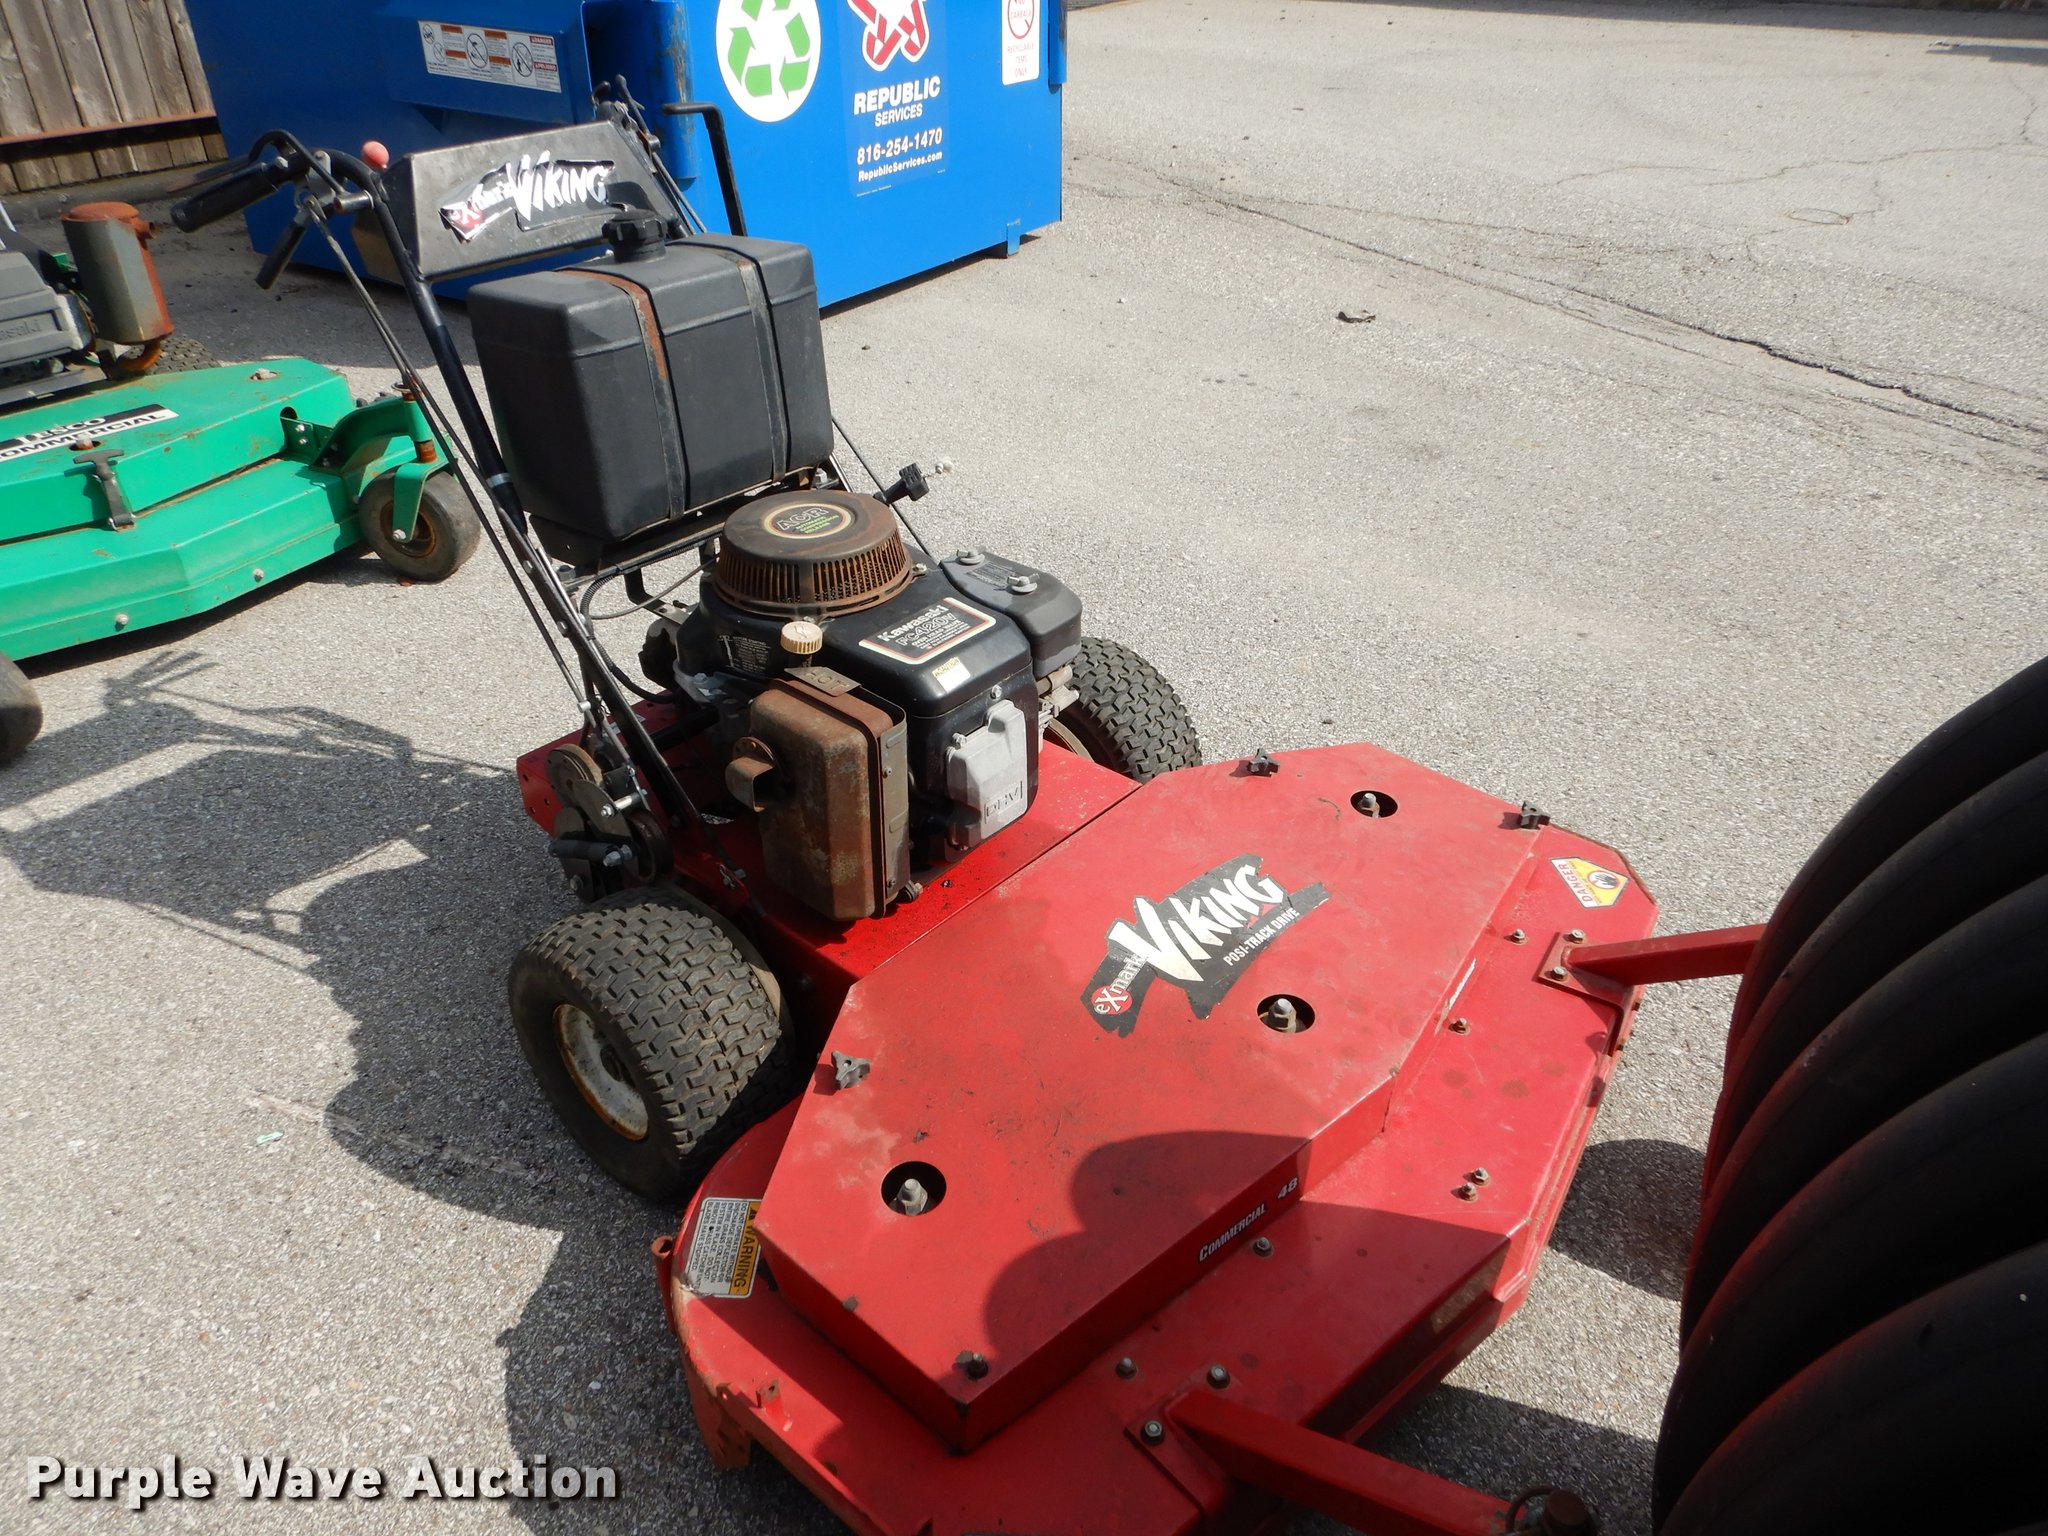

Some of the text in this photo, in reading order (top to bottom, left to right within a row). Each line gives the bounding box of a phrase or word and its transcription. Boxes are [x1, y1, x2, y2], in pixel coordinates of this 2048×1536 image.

[853, 76, 941, 115] REPUBLIC
[874, 103, 923, 127] SERVICES
[857, 127, 943, 165] 816-254-1470
[858, 151, 943, 183] RepublicServices.com
[0, 414, 166, 460] OMMERCIAL
[777, 507, 829, 531] ACR
[877, 604, 949, 642] Kawasaki
[1558, 863, 1593, 902] DANGER
[1094, 864, 1284, 1015] eXmark VIKING
[1223, 907, 1301, 967] POSI-TRACK DRIVE
[741, 1203, 747, 1211] DO
[1199, 1177, 1298, 1262] COMMERCIAL 48
[734, 1226, 755, 1288] WARNING
